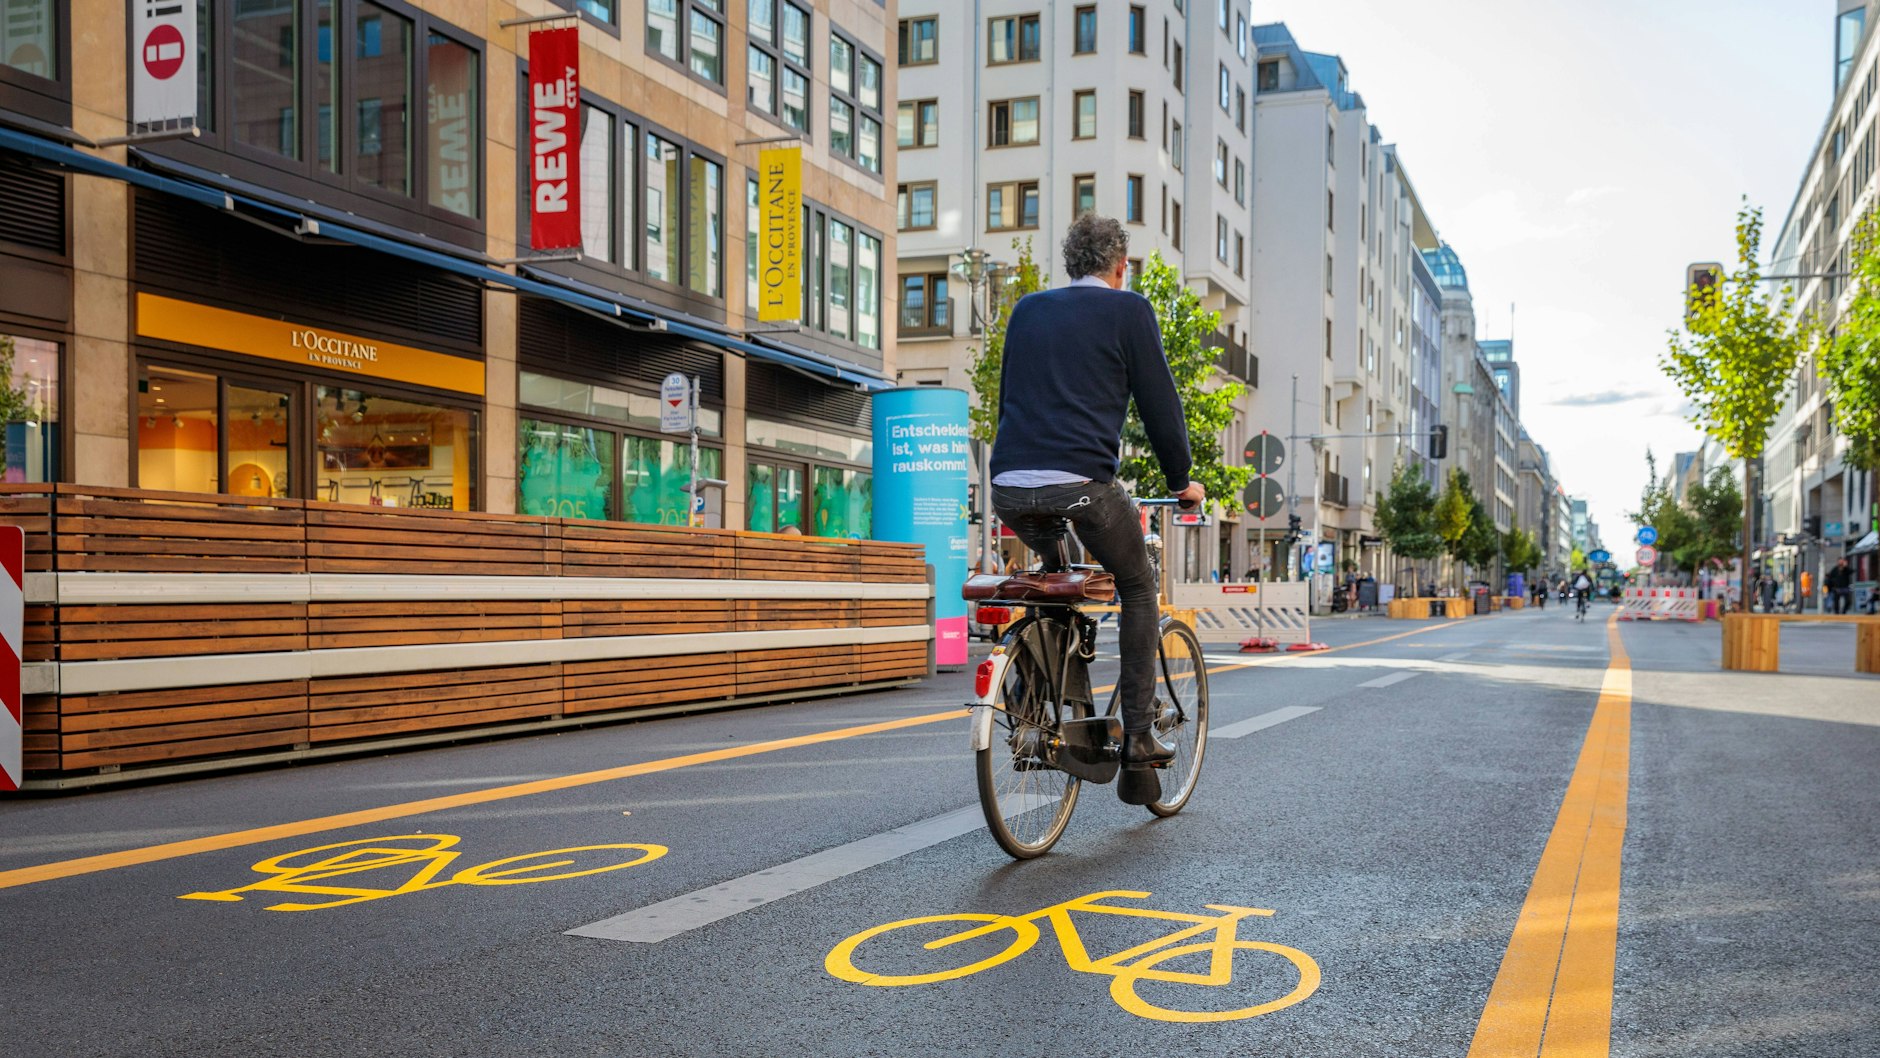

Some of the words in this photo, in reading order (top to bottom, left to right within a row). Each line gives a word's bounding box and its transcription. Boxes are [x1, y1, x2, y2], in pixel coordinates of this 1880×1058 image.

[565, 65, 577, 109] CITY
[534, 78, 568, 214] REWE
[764, 162, 785, 307] L'OCCITANE
[787, 189, 796, 259] PROVENCE
[787, 262, 796, 278] EN
[291, 330, 378, 362] L'OCCITANE
[309, 352, 321, 362] EN
[322, 355, 363, 370] PROVENCE
[671, 376, 680, 385] 30
[892, 441, 914, 457] ist,
[918, 443, 949, 455] was
